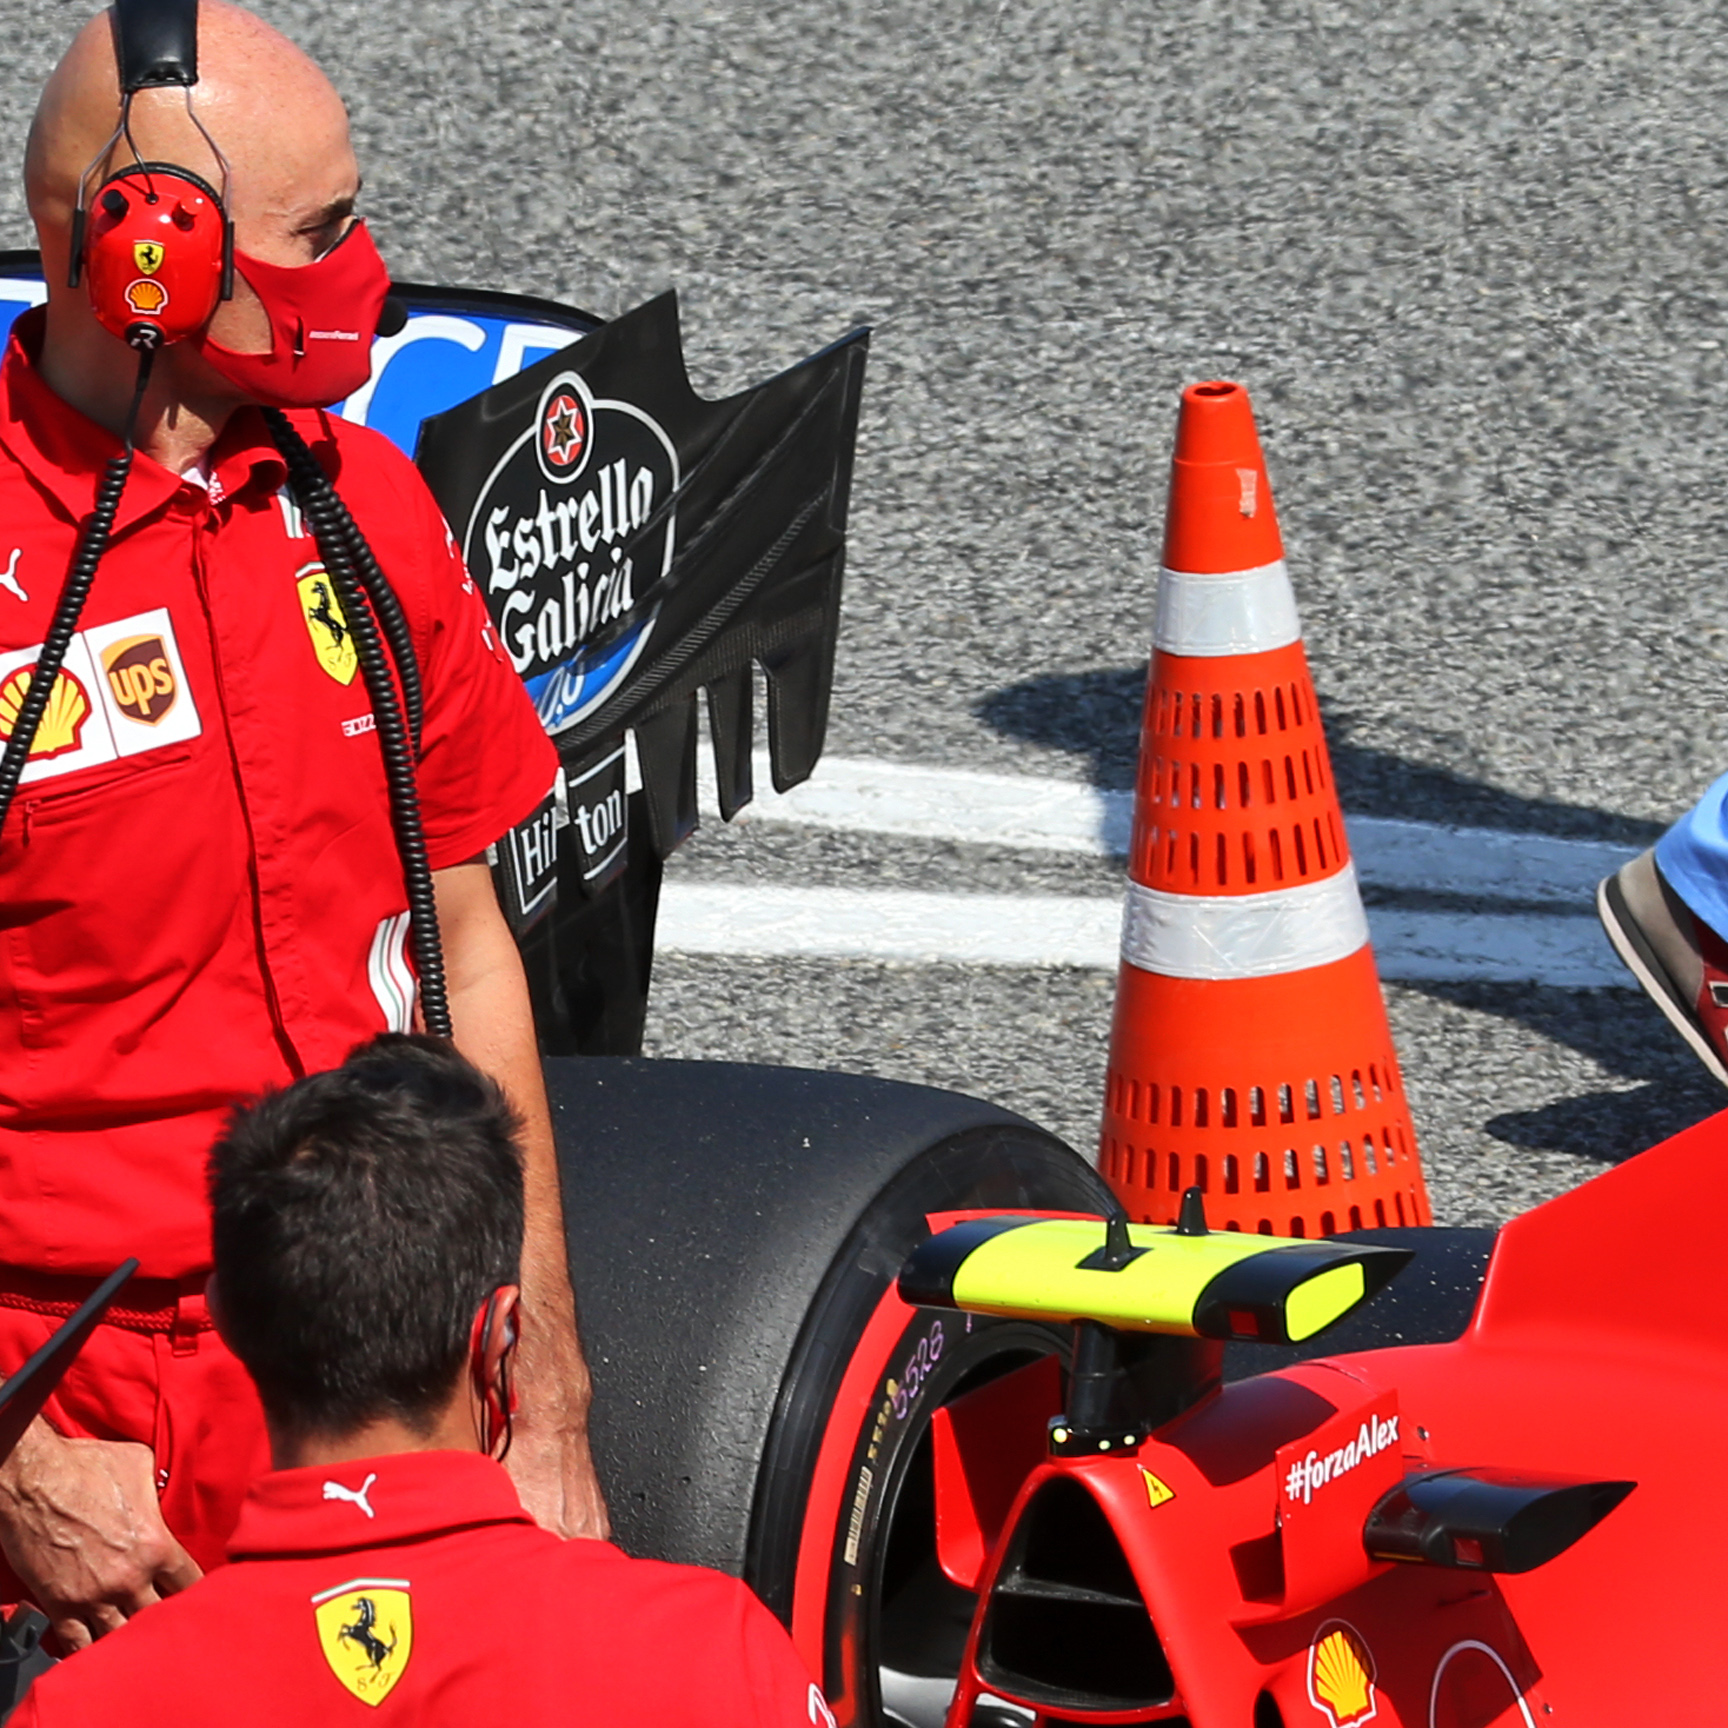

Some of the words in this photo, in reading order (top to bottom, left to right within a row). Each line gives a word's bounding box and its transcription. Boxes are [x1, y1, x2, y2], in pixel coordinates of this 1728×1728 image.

[485, 458, 653, 595] Estrella
[500, 548, 634, 675] Galicia
[109, 657, 174, 716] ups
[1284, 1413, 1400, 1506] #forzaAlex
